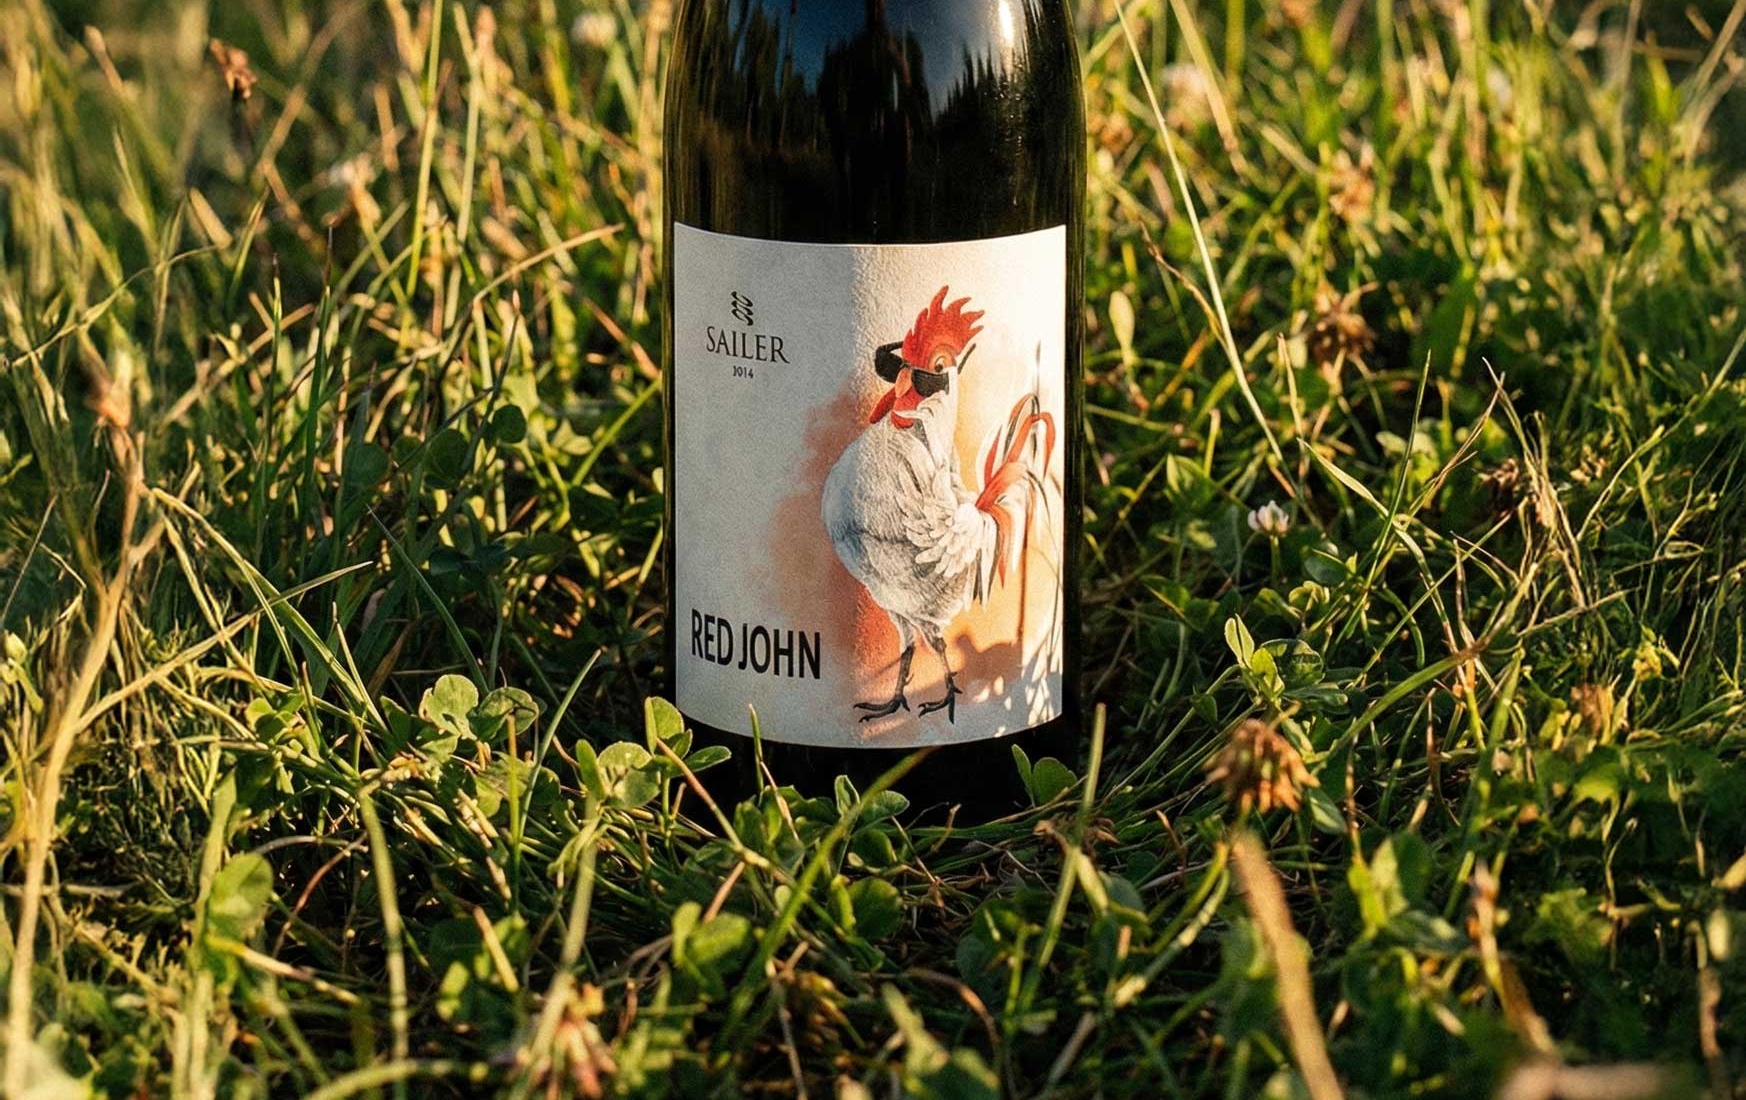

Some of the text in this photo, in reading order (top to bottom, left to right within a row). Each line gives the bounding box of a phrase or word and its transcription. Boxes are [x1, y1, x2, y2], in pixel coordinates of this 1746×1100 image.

[706, 326, 791, 364] SAILER
[691, 608, 821, 680] RED JOHN
